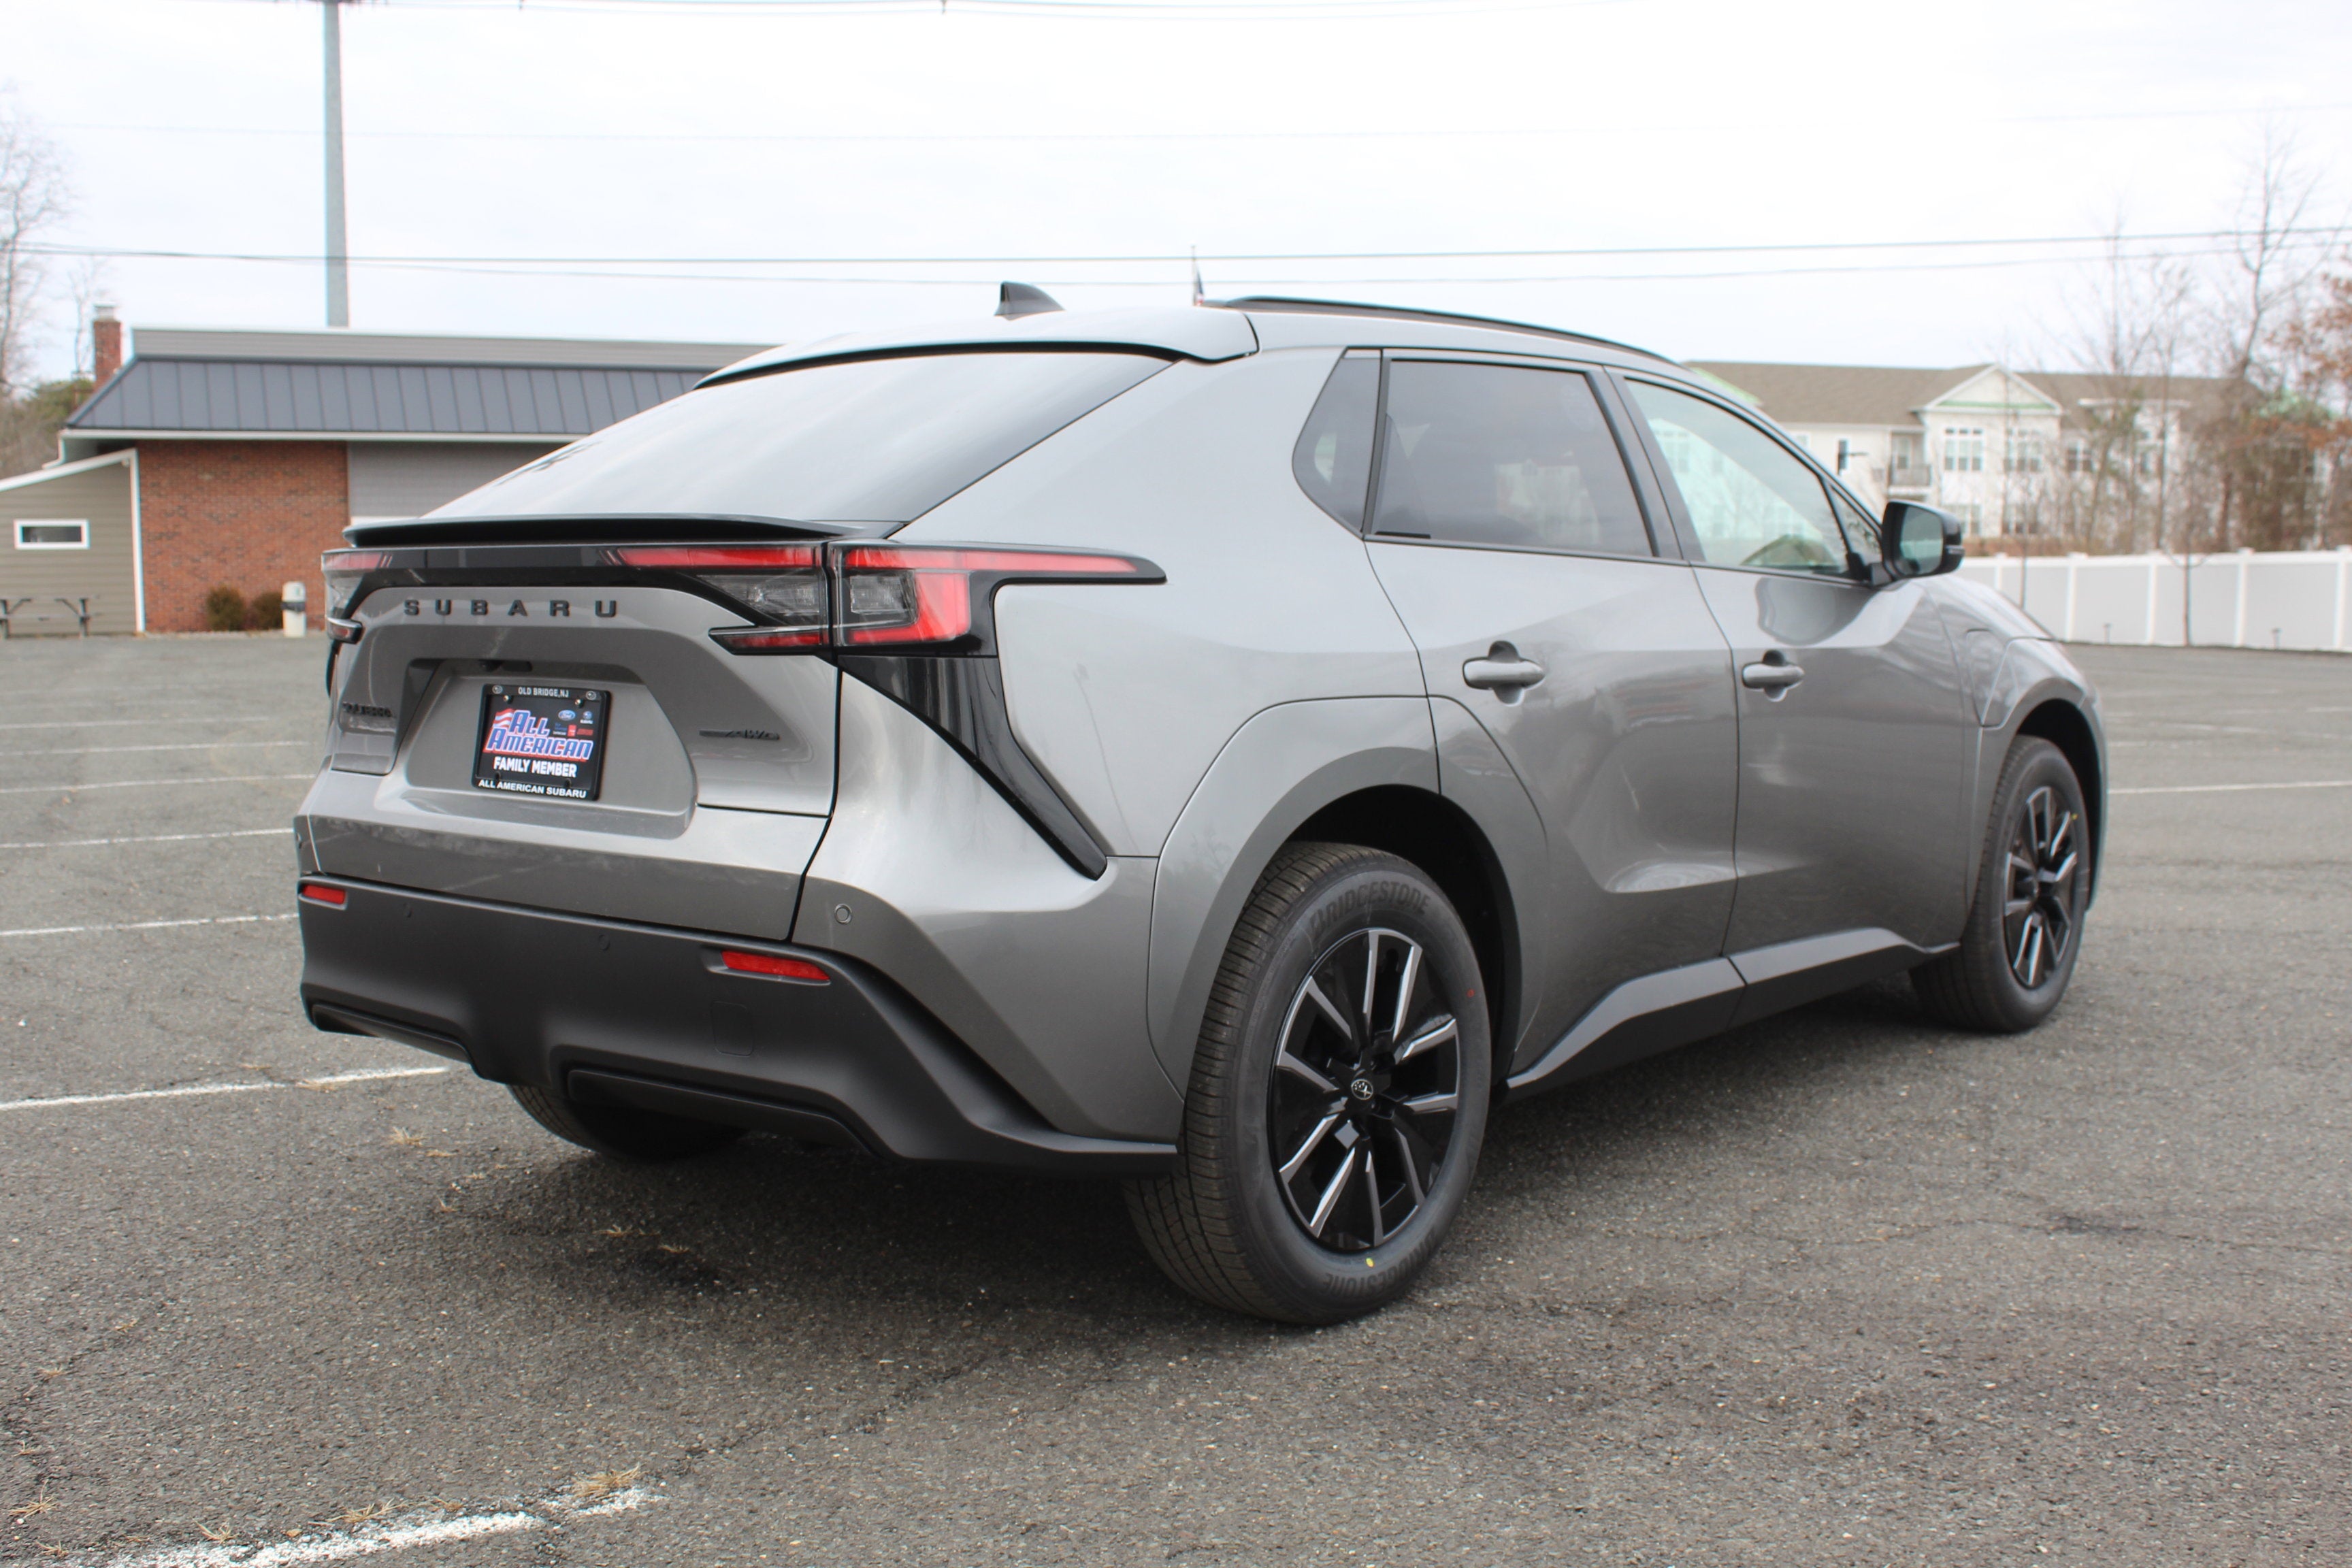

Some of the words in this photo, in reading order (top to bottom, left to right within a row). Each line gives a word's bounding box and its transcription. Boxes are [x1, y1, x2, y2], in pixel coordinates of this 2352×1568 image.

[404, 599, 617, 618] SUBARU
[518, 687, 532, 695] OLD
[493, 756, 531, 772] FAMILY
[532, 760, 578, 778] MEMBER
[478, 779, 495, 789] ALL
[497, 781, 544, 794] AMERICAN
[546, 787, 587, 798] SUBARU
[1309, 881, 1431, 936] BRIDGESTONE
